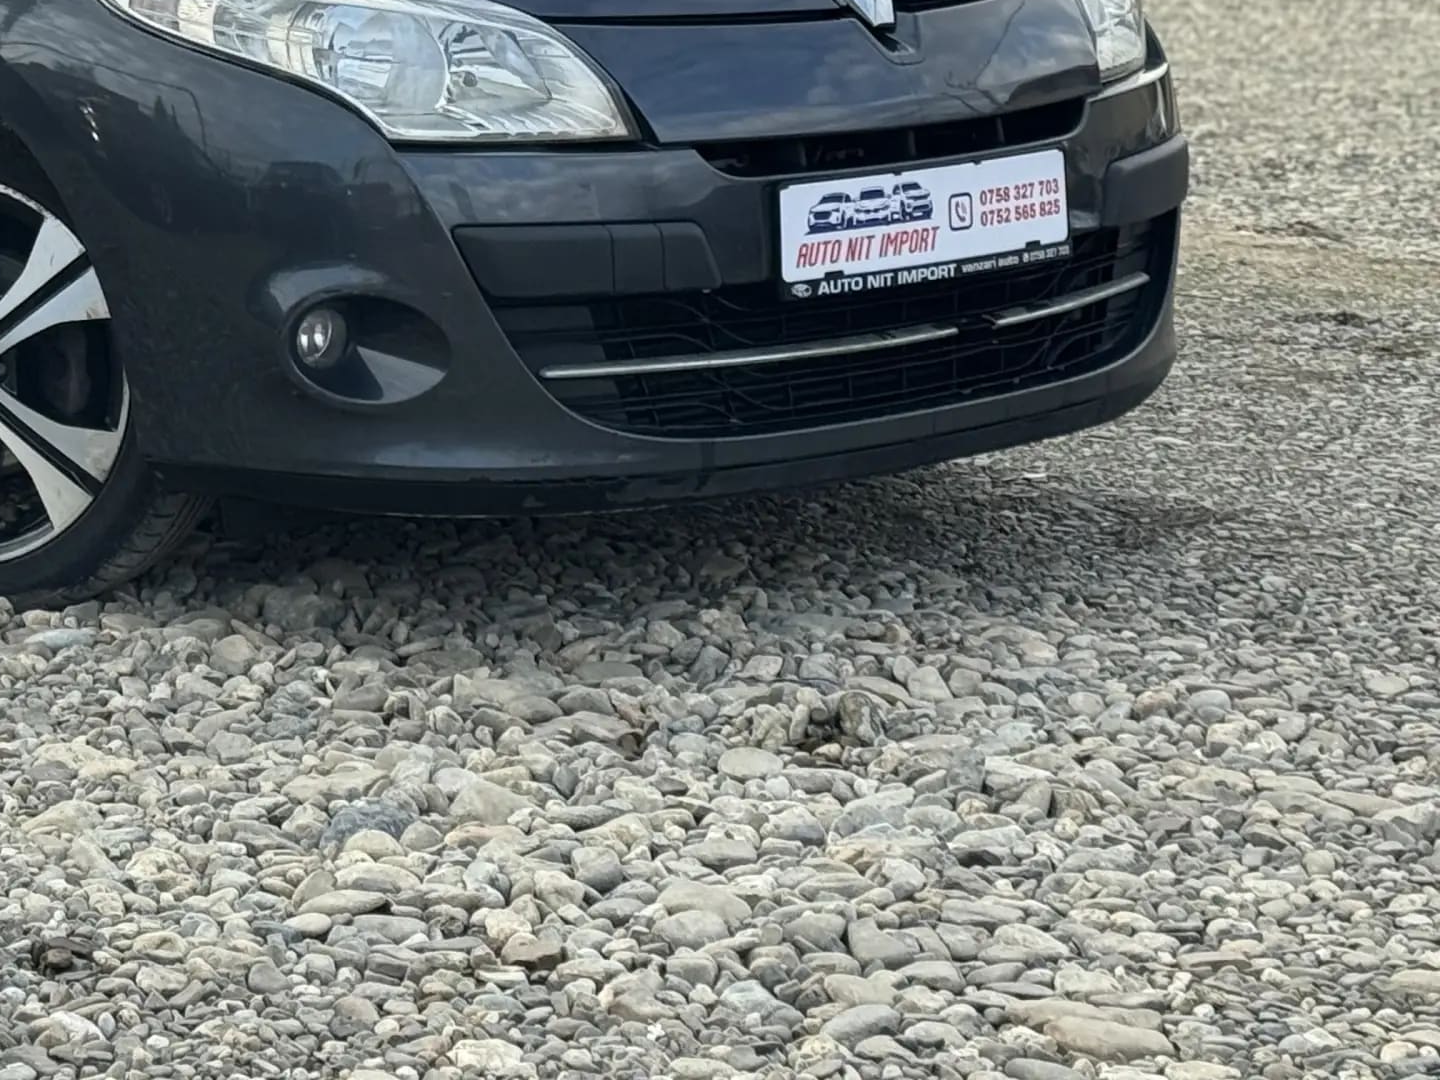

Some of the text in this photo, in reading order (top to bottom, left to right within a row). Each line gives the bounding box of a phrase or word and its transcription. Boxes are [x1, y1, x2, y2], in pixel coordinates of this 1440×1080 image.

[980, 178, 1060, 206] 0758 327 703
[980, 207, 1012, 227] 0752
[1040, 199, 1061, 218] 825
[796, 225, 941, 269] AUTO NIT IMPORT
[818, 277, 864, 296] AUTO
[868, 272, 895, 290] NIT
[897, 263, 958, 286] IMPORT
